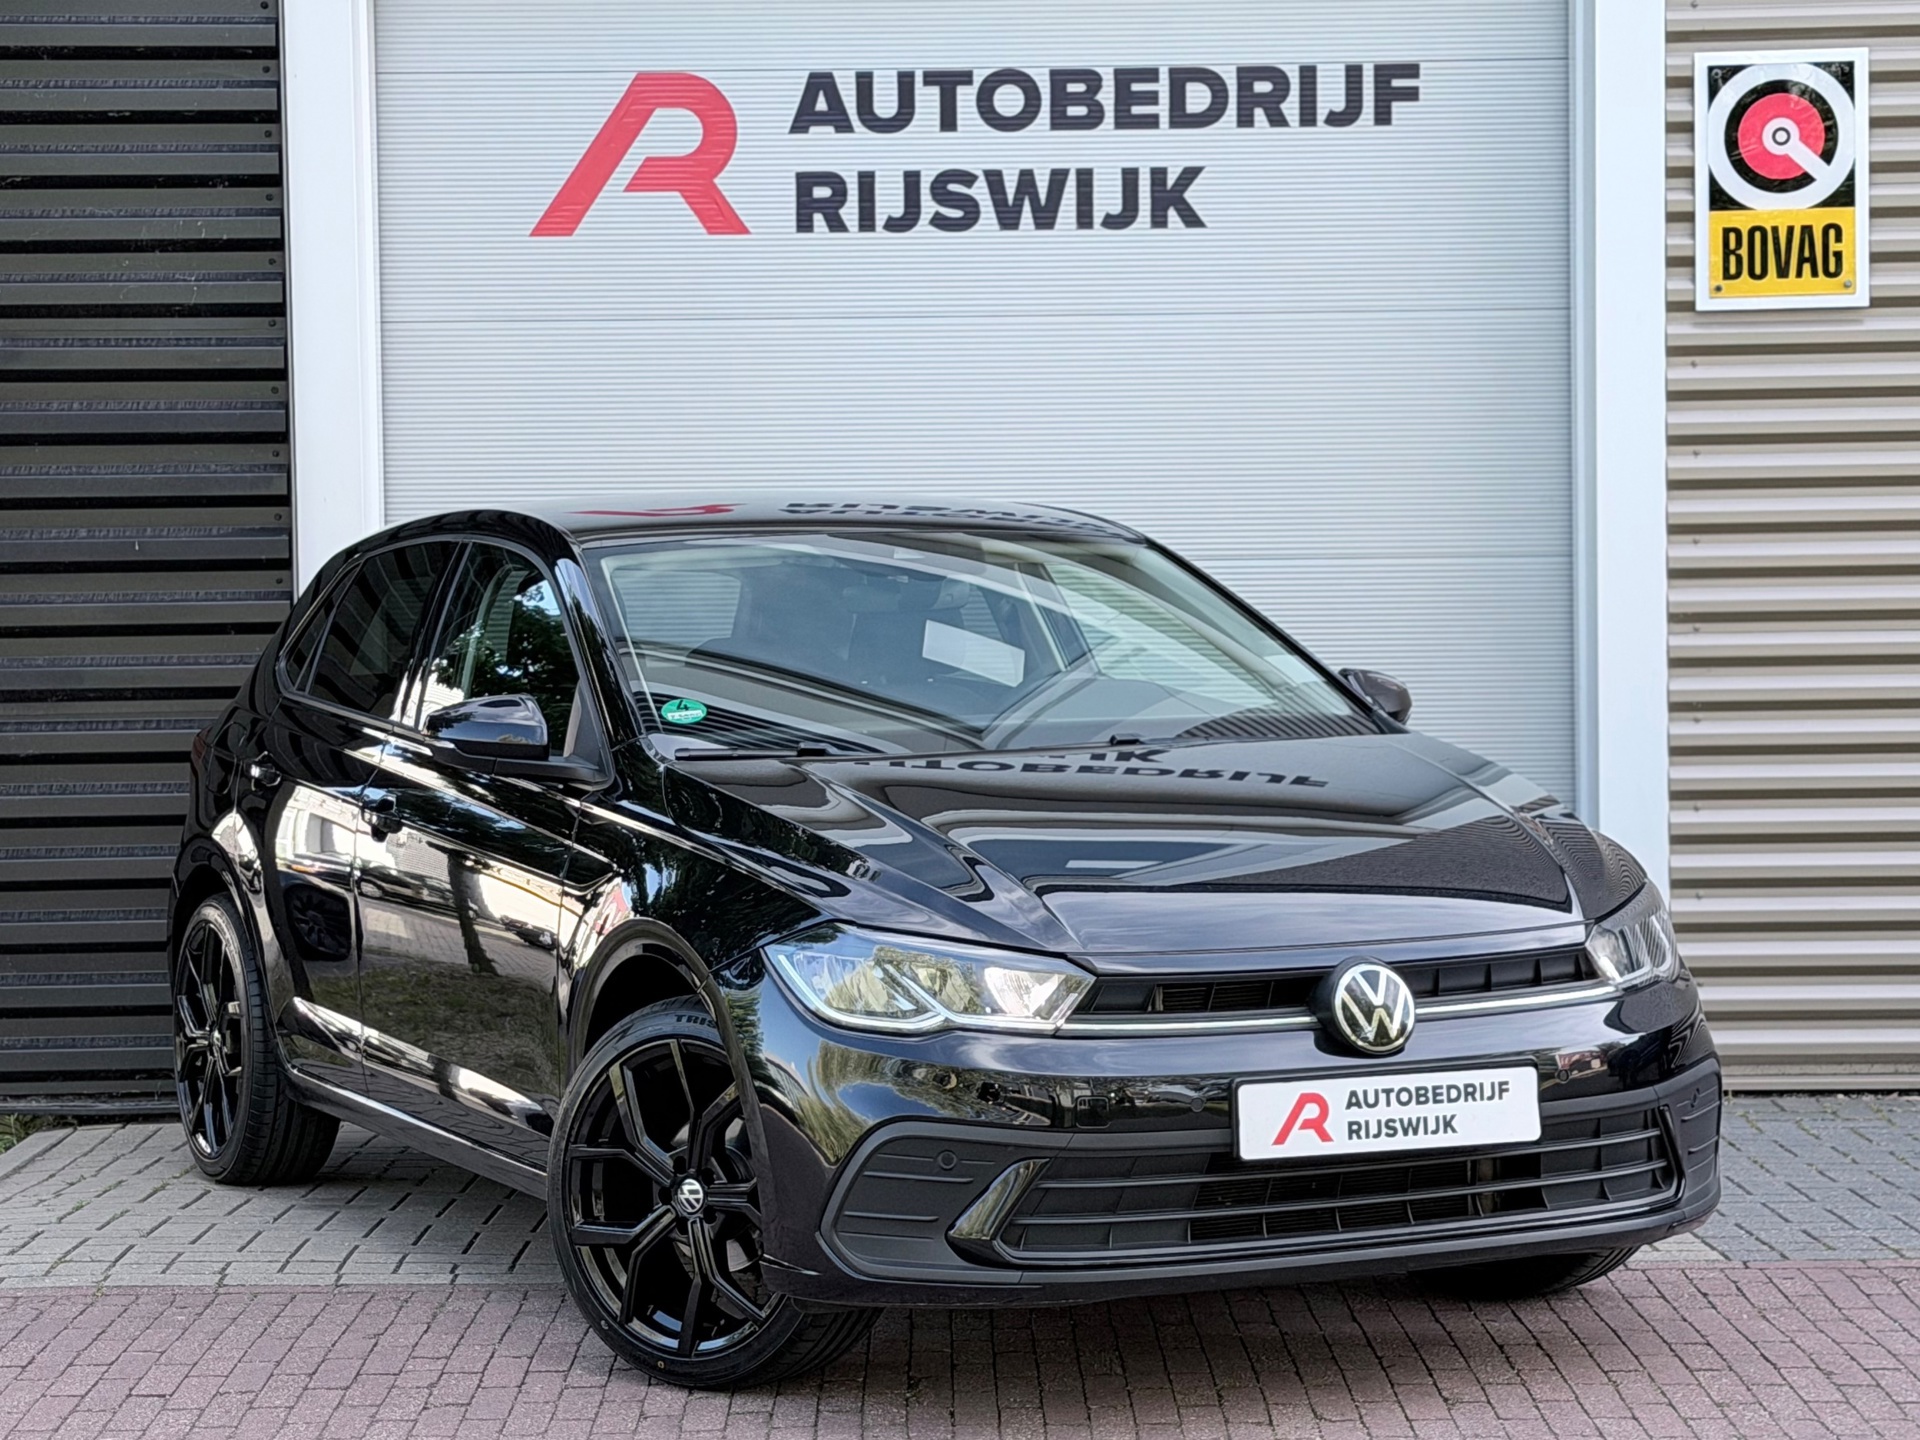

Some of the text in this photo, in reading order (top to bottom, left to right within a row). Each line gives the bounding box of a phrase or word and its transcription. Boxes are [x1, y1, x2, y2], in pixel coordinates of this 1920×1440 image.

[789, 63, 1420, 134] AUTOBEDRIJF
[795, 166, 1207, 233] RIJSWIJK
[1722, 223, 1843, 281] BOVAG
[1345, 1080, 1510, 1110] AUTOBEDRIJF
[1347, 1114, 1459, 1141] RIJSWIJK
